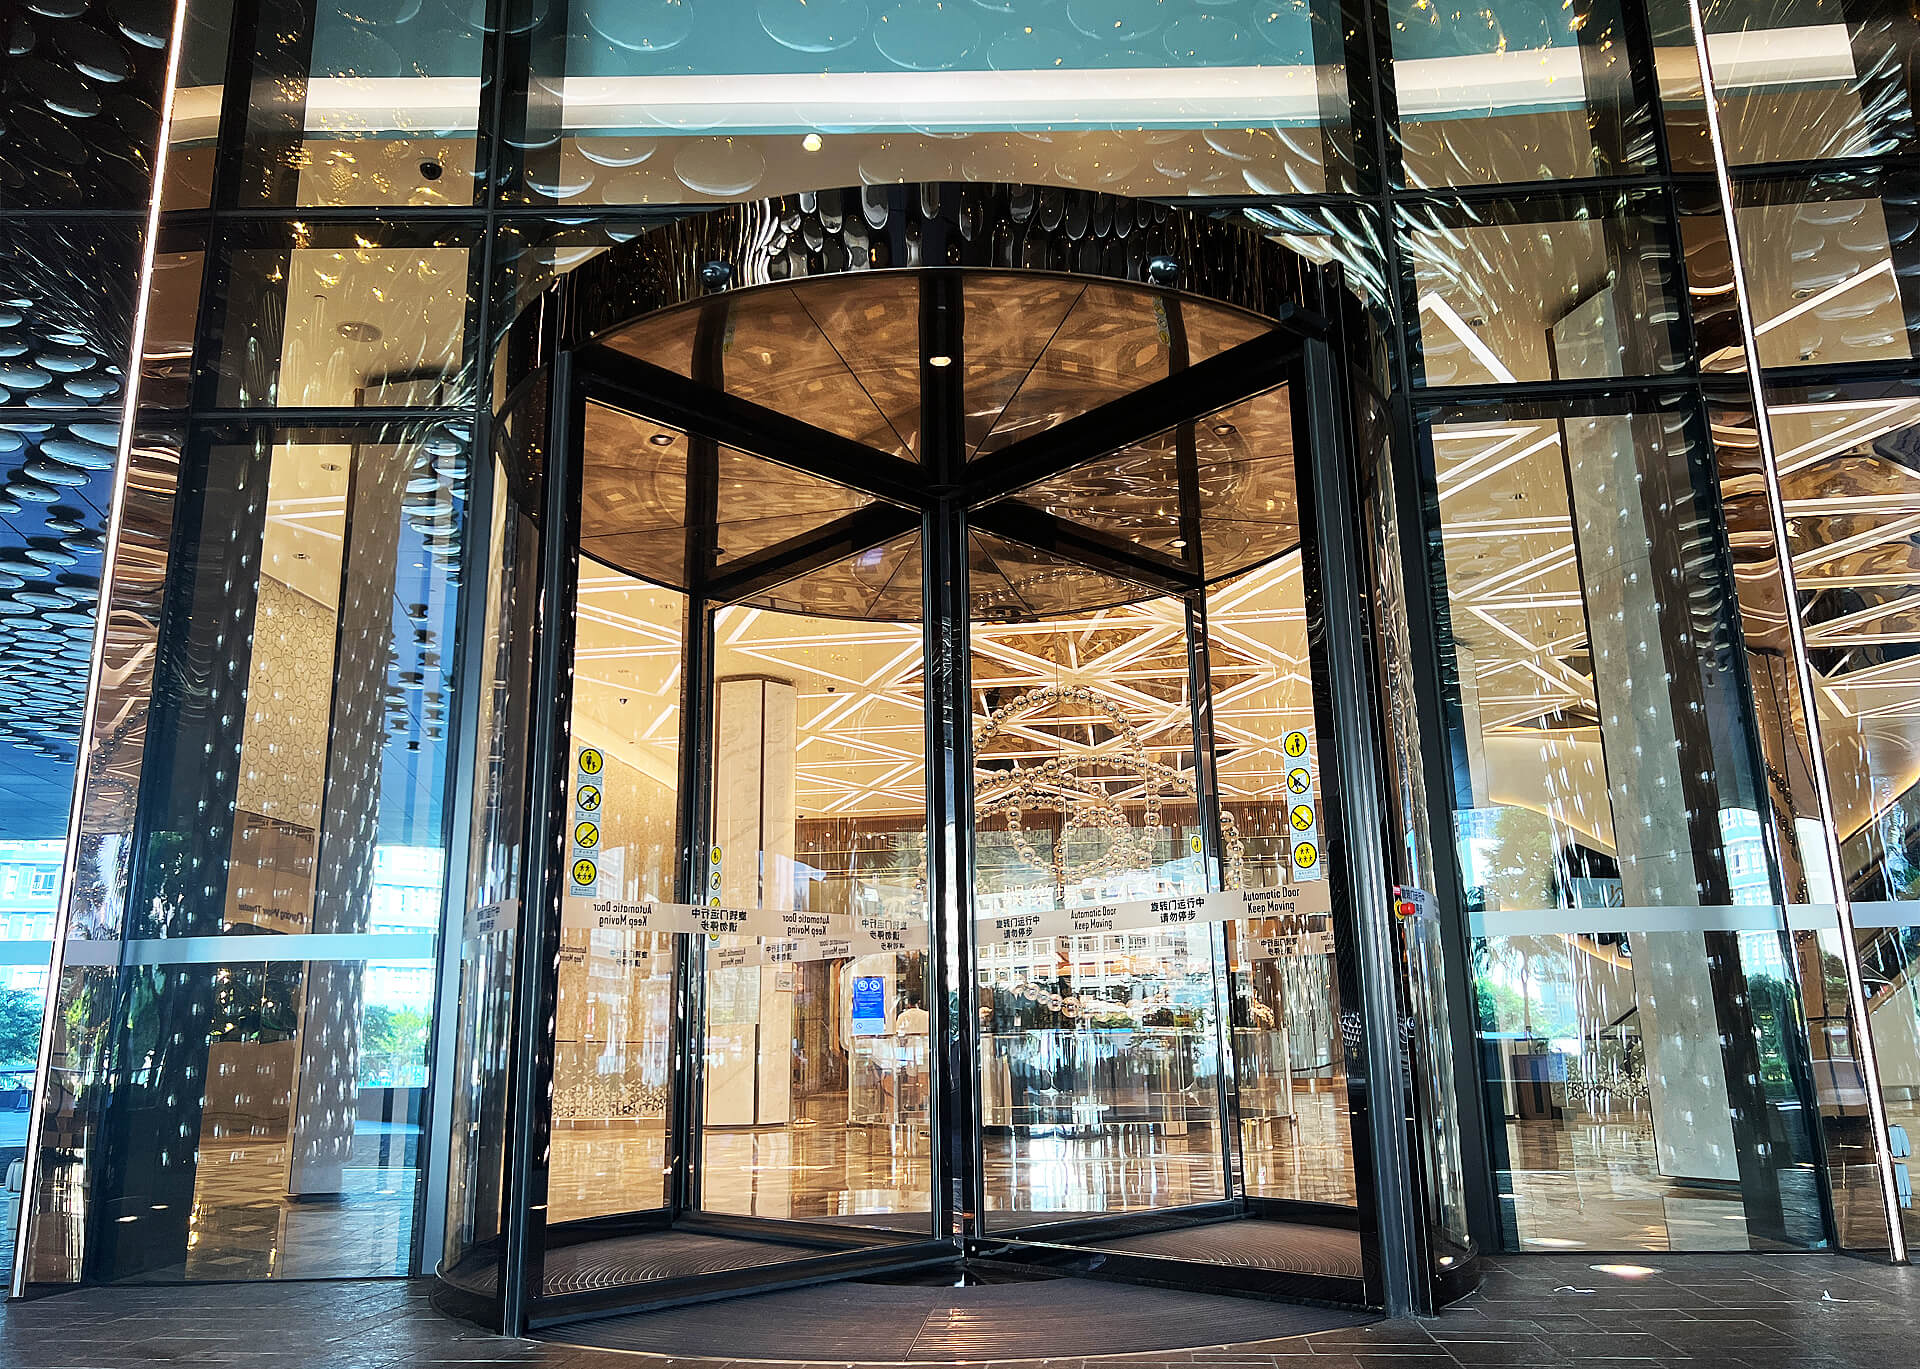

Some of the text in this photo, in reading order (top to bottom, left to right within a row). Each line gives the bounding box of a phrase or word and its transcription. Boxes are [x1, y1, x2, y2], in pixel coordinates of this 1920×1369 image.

[1242, 886, 1300, 903] Automatic Door
[1150, 897, 1205, 912] 旋转门运行中
[1248, 900, 1295, 914] Keep Moving
[1071, 906, 1117, 920] Automatic Door
[1160, 910, 1196, 923] 请勿停步
[996, 916, 1041, 929] 旋转门运行中
[1075, 919, 1113, 932] Keep Moving
[1003, 928, 1033, 939] 请勿停步
